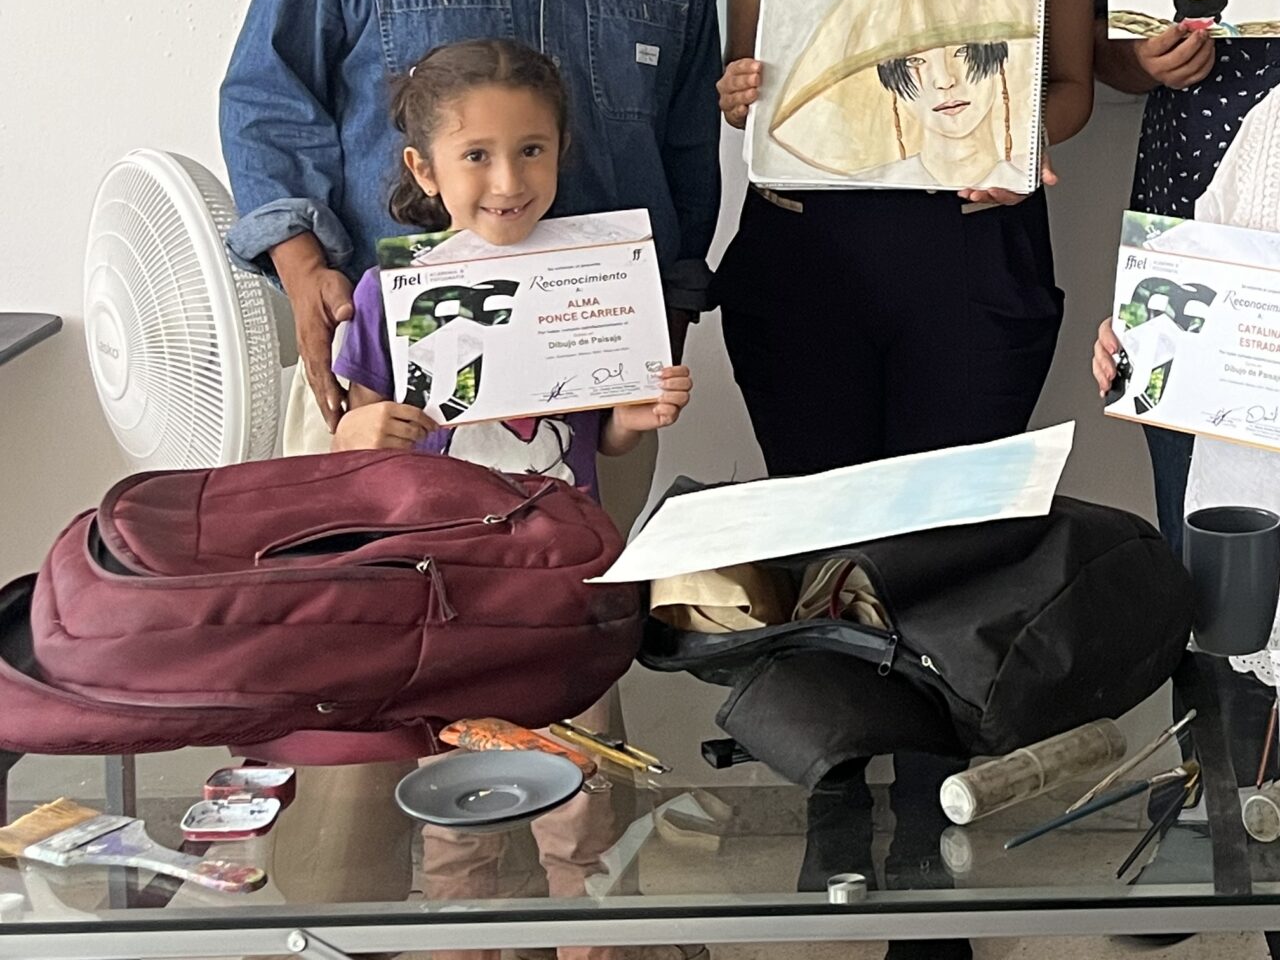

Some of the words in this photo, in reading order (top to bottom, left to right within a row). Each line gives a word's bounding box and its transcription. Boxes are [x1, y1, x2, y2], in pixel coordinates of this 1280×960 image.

[529, 272, 627, 292] Reconocimiento
[567, 297, 600, 308] ALMA
[538, 312, 578, 325] PONCE
[580, 306, 636, 320] CARRERA
[548, 340, 577, 349] Dibujo
